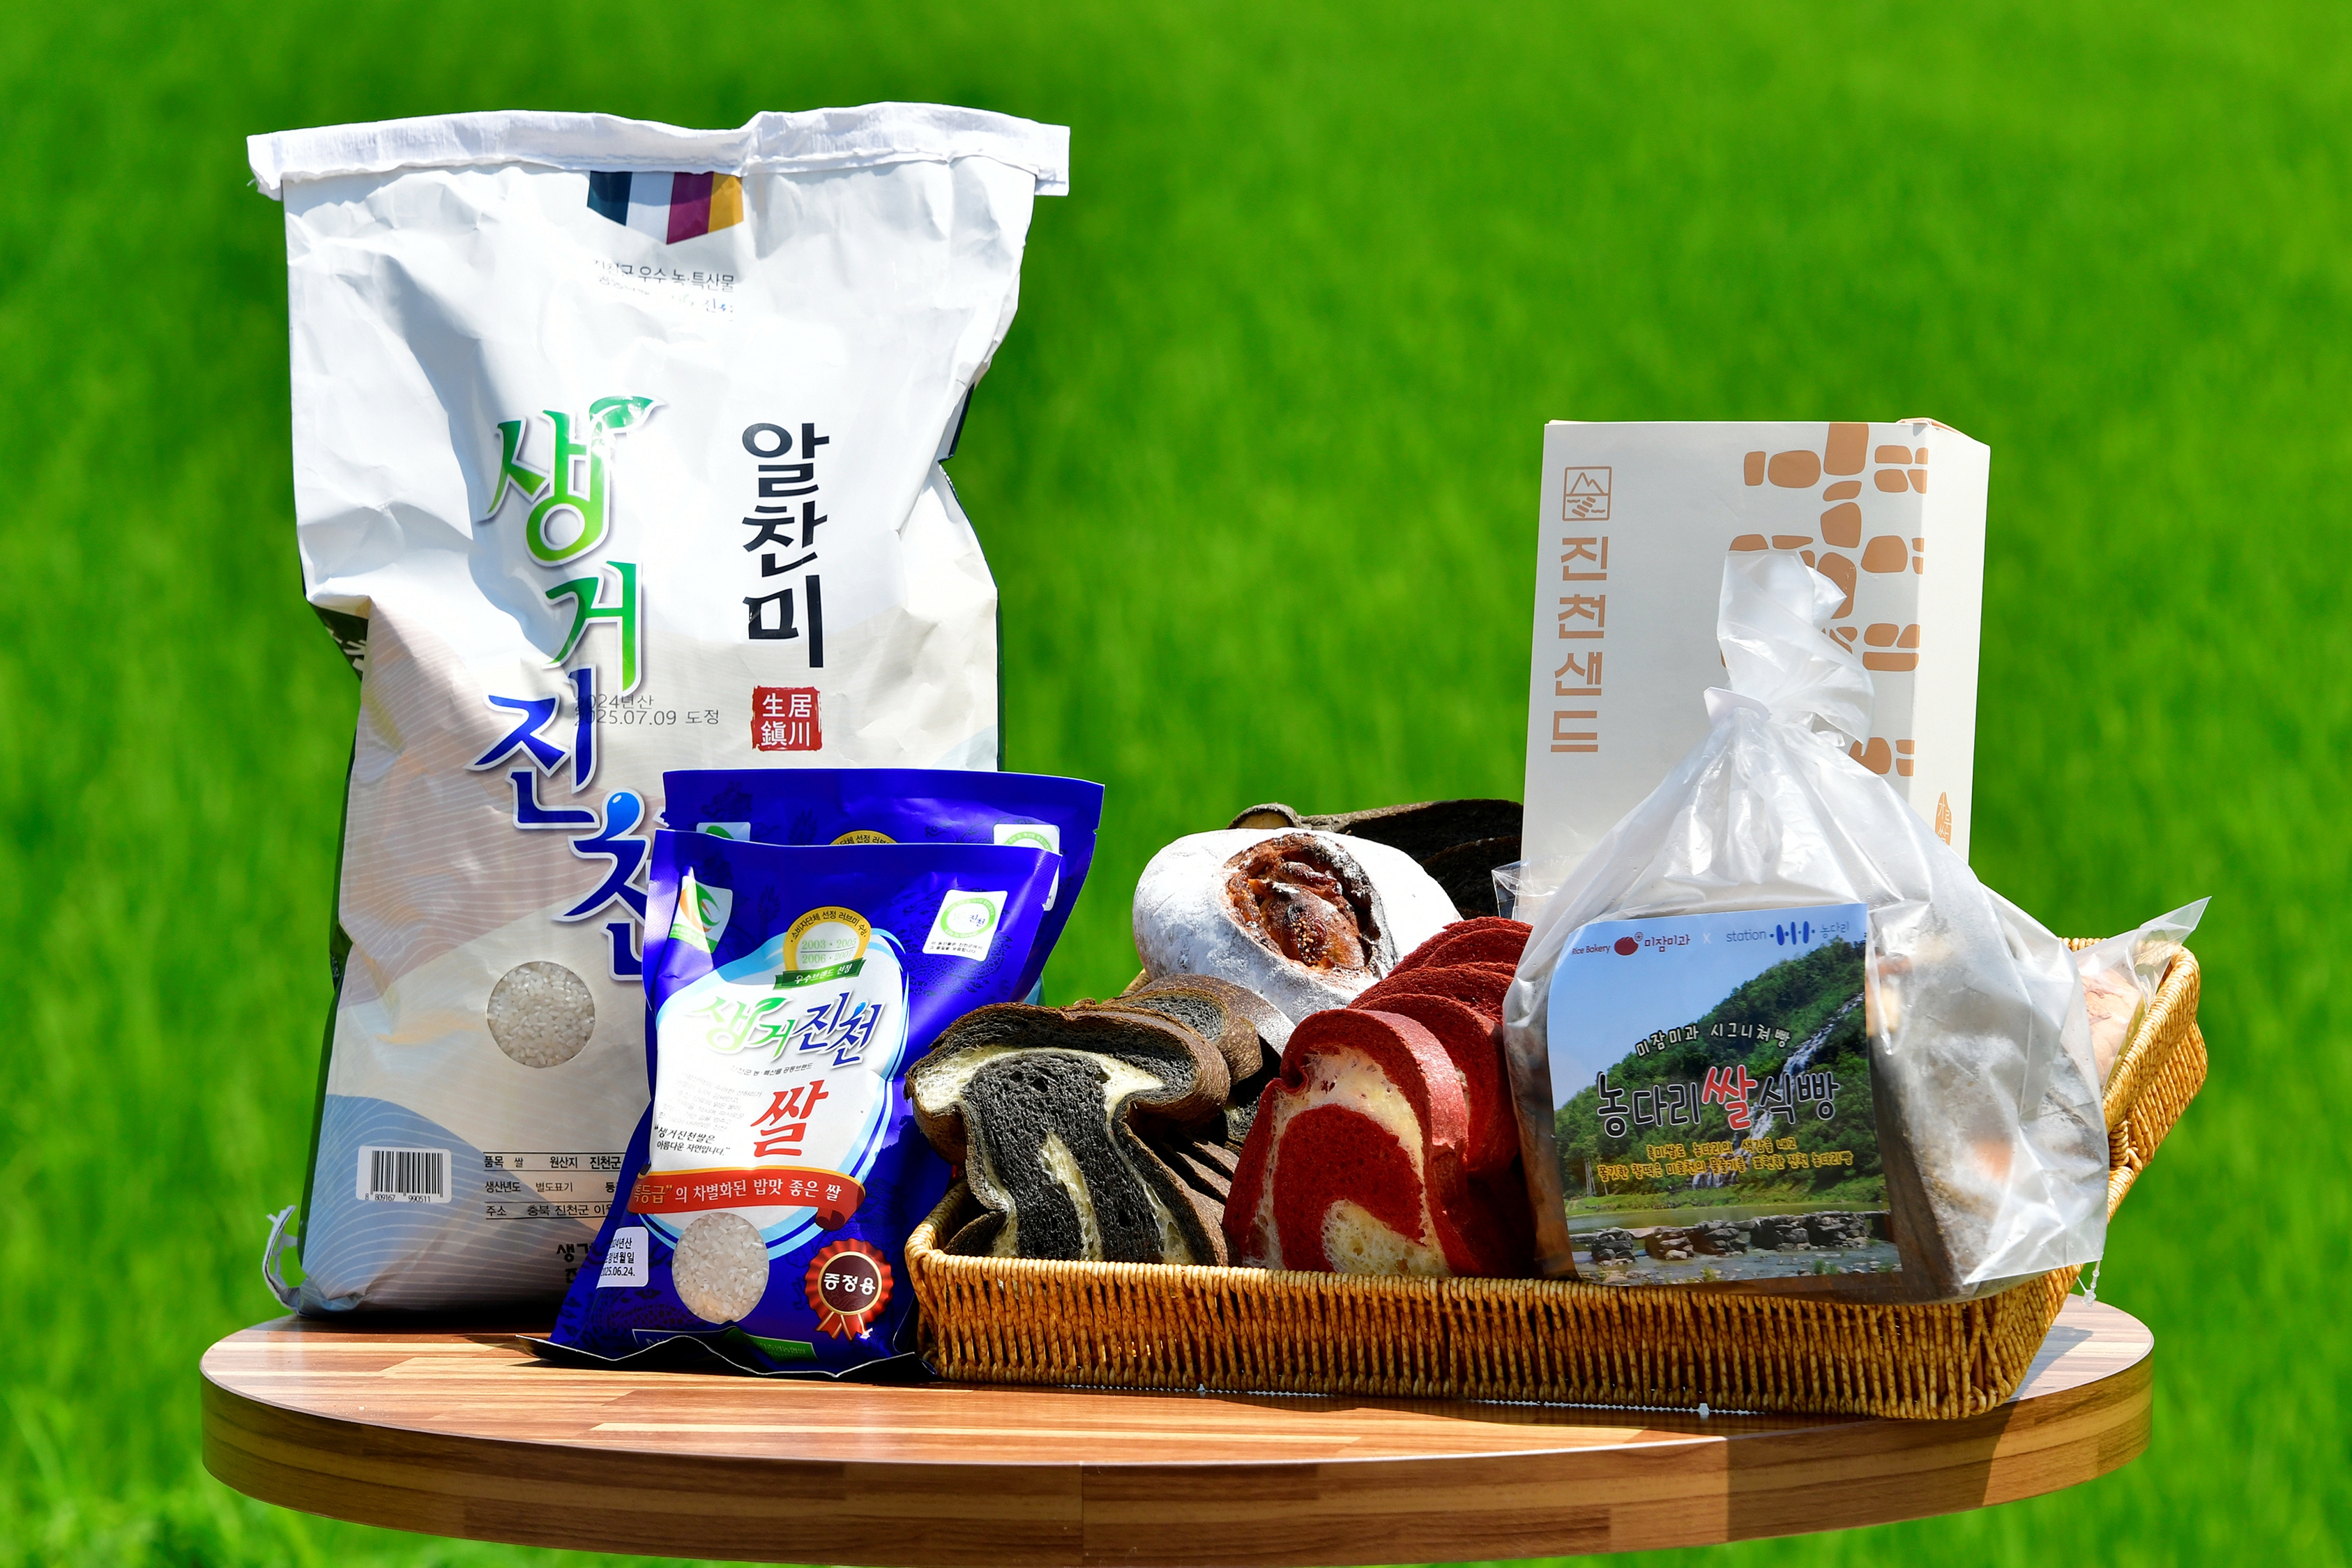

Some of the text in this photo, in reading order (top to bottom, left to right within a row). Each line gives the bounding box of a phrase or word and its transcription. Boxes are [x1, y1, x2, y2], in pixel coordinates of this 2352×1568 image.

[638, 266, 667, 284] 우수
[741, 423, 830, 668] 알찬미
[1550, 535, 1609, 753] 진천샌드
[685, 709, 719, 725] 도정
[856, 835, 871, 844] 선정
[791, 913, 821, 940] 소비자단체
[821, 911, 837, 920] 선정
[838, 911, 860, 926] 러브미
[802, 938, 857, 950] 2003 2005
[1571, 946, 1584, 955] Rice
[1586, 944, 1611, 954] Bakery
[1644, 934, 1691, 952] 미잠미과
[1725, 929, 1767, 943] station
[1820, 921, 1849, 938] 농다리
[802, 950, 853, 964] 2006 2007
[794, 963, 853, 984] 우수브랜드 선정
[687, 990, 885, 1068] 생거진천
[1635, 1022, 1791, 1057] 미잠미과 시그니쳐 빵
[750, 1079, 830, 1159] 쌀
[657, 1140, 684, 1152] 아름다운
[1692, 1141, 1733, 1157] 농다리의
[1740, 1136, 1774, 1153] 색감을
[484, 1156, 621, 1169] 품목 쌀 원산지 진천군
[1631, 1162, 1662, 1180] 찰떡은
[1665, 1160, 1707, 1175] 미호천의
[1709, 1155, 1746, 1175] 물줄기를
[1752, 1153, 1786, 1171] 표현한
[1786, 1152, 1810, 1169] 진천
[1812, 1150, 1854, 1168] 농다리빵
[485, 1181, 618, 1193] 생산년도 별도표기 등
[675, 1186, 688, 1203] 의
[693, 1180, 747, 1202] 차별화된
[753, 1178, 783, 1196] 밥맛
[789, 1180, 819, 1198] 좋은
[826, 1184, 842, 1202] 쌀
[375, 1193, 396, 1202] 809167
[408, 1195, 431, 1203] 990511
[486, 1205, 507, 1216] 주소
[527, 1205, 550, 1216] 충북
[554, 1204, 589, 1216] 진천군
[824, 1272, 876, 1295] 증정용
